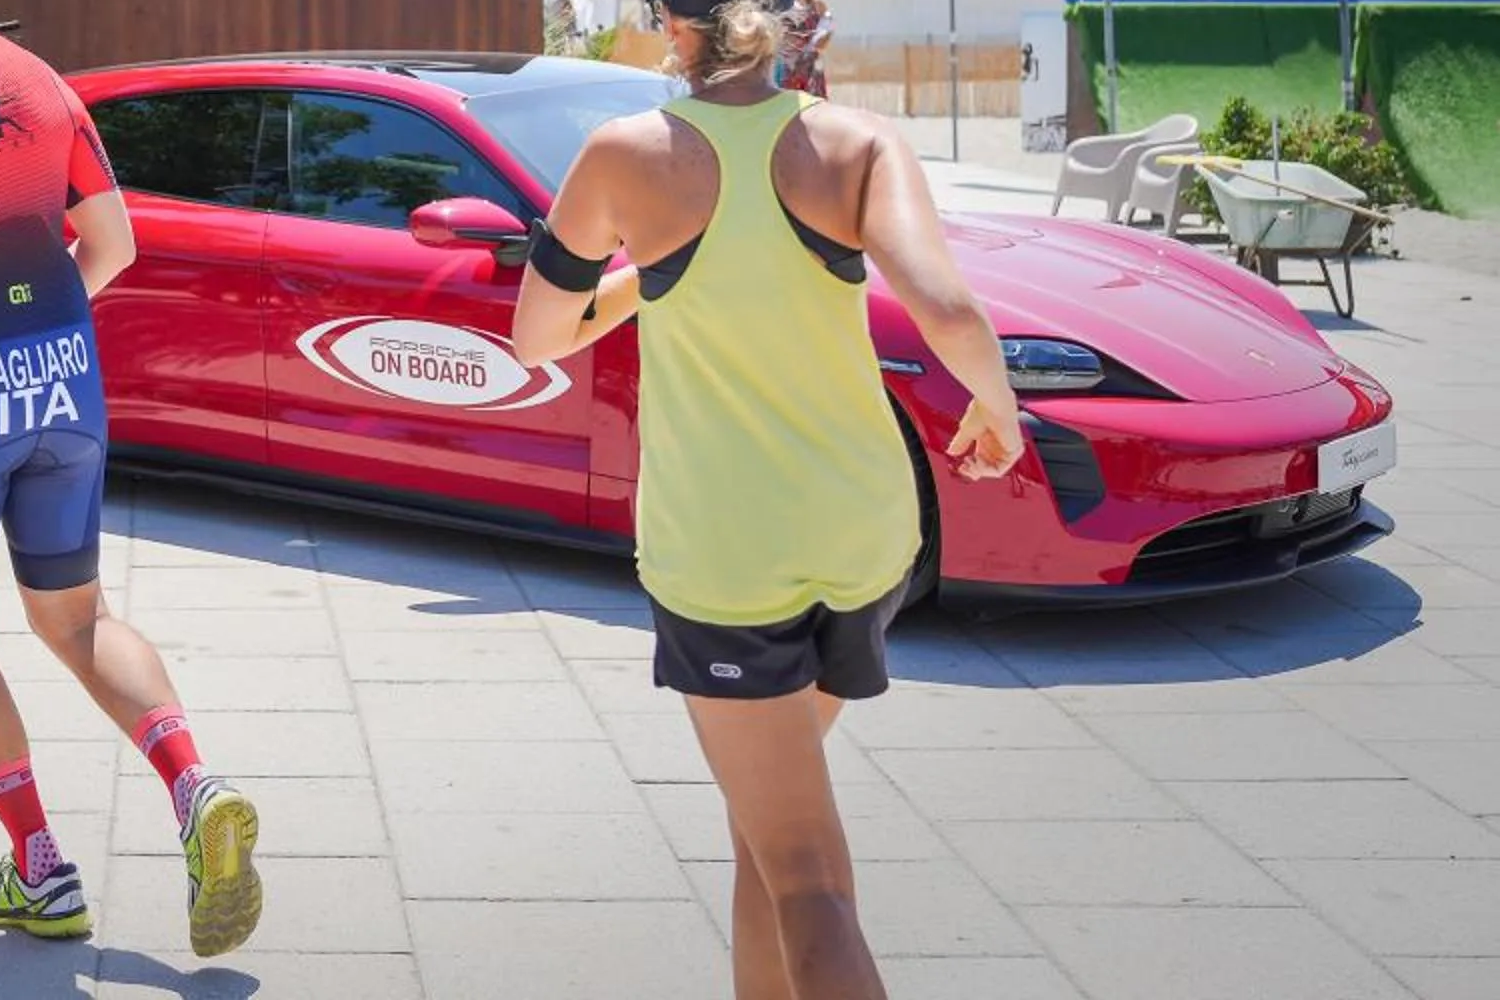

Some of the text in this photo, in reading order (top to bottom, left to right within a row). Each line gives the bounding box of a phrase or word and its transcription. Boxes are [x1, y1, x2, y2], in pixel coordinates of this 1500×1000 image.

[369, 336, 486, 364] PORSCHE
[371, 349, 487, 388] ON BOARD
